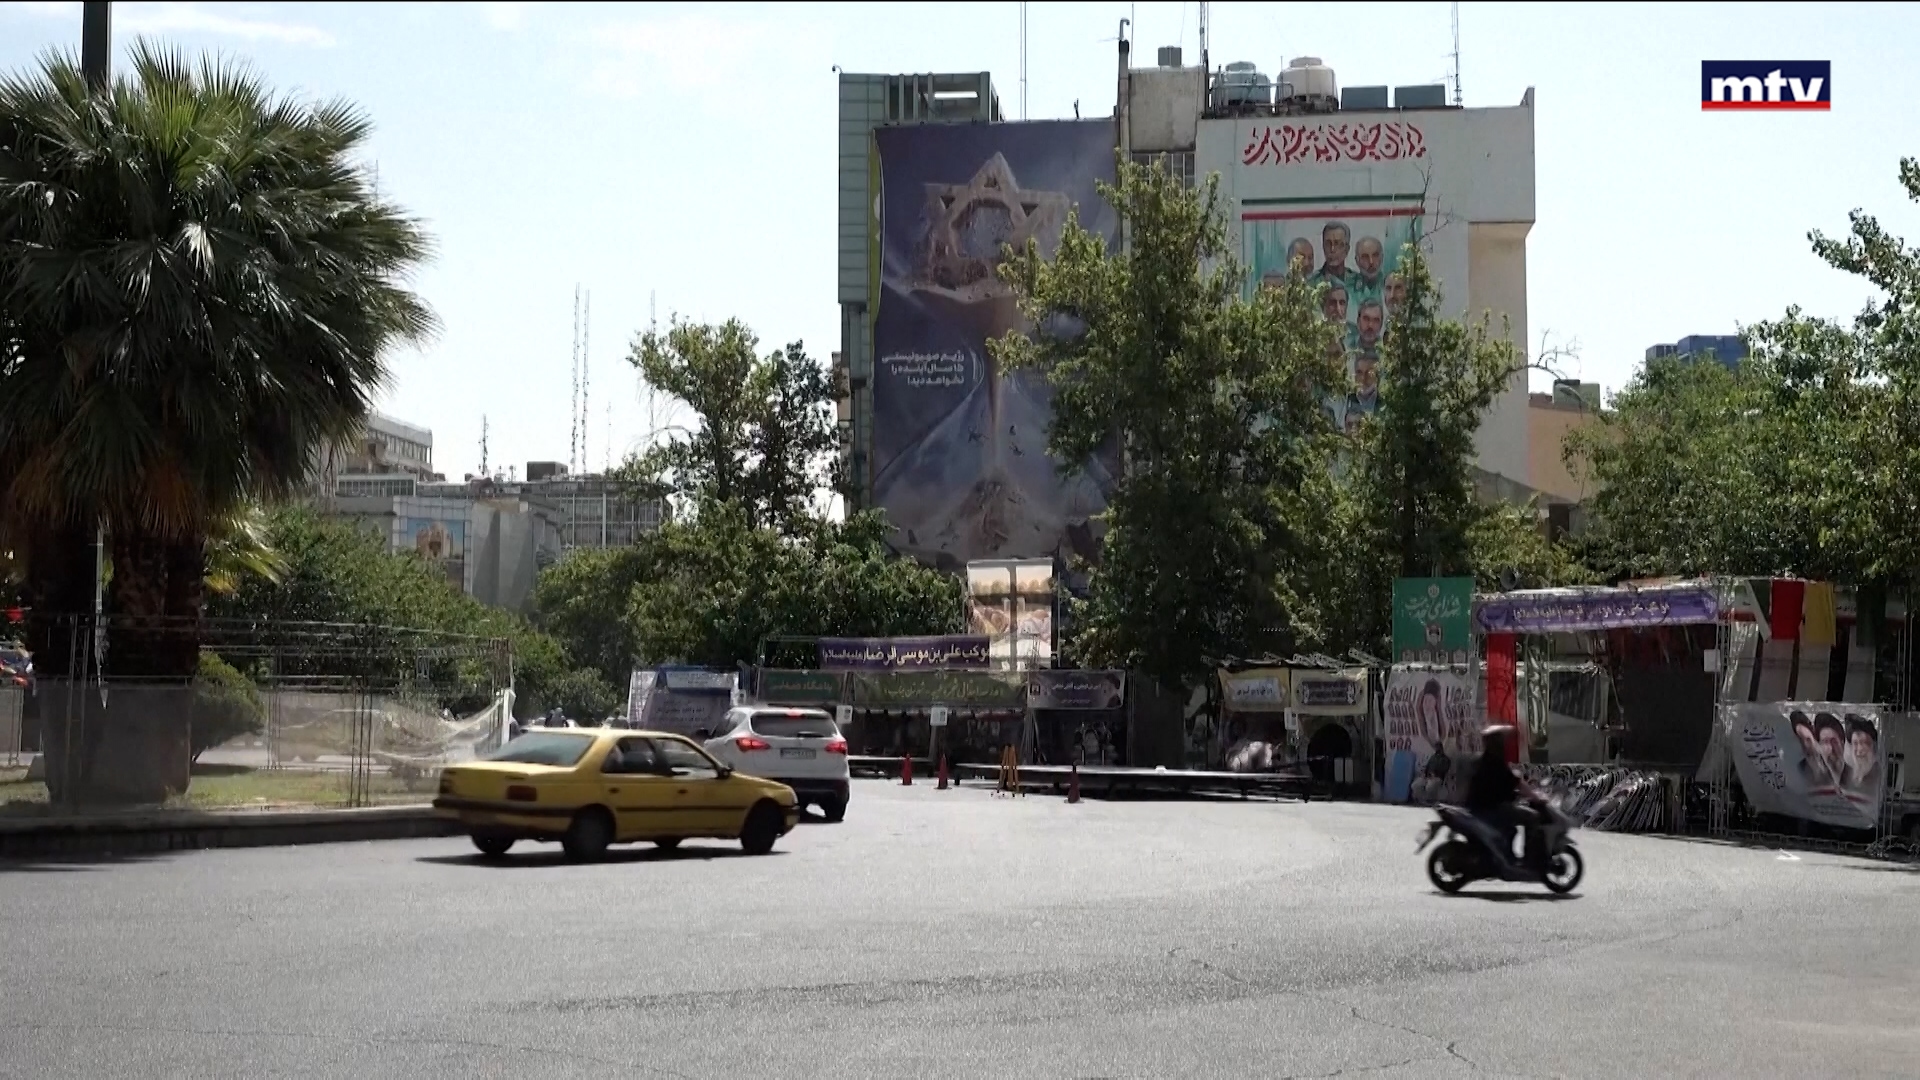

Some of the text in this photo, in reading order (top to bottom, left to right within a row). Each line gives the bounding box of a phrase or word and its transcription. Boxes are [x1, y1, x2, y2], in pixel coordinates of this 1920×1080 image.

[881, 351, 965, 363] رژیم صهیونیستی
[898, 362, 927, 375] آینده
[927, 363, 953, 374] سال
[925, 374, 965, 388] نخواهد
[865, 645, 897, 666] الرضا
[896, 649, 928, 666] موسی
[928, 647, 940, 663] بن
[939, 644, 961, 662] علی
